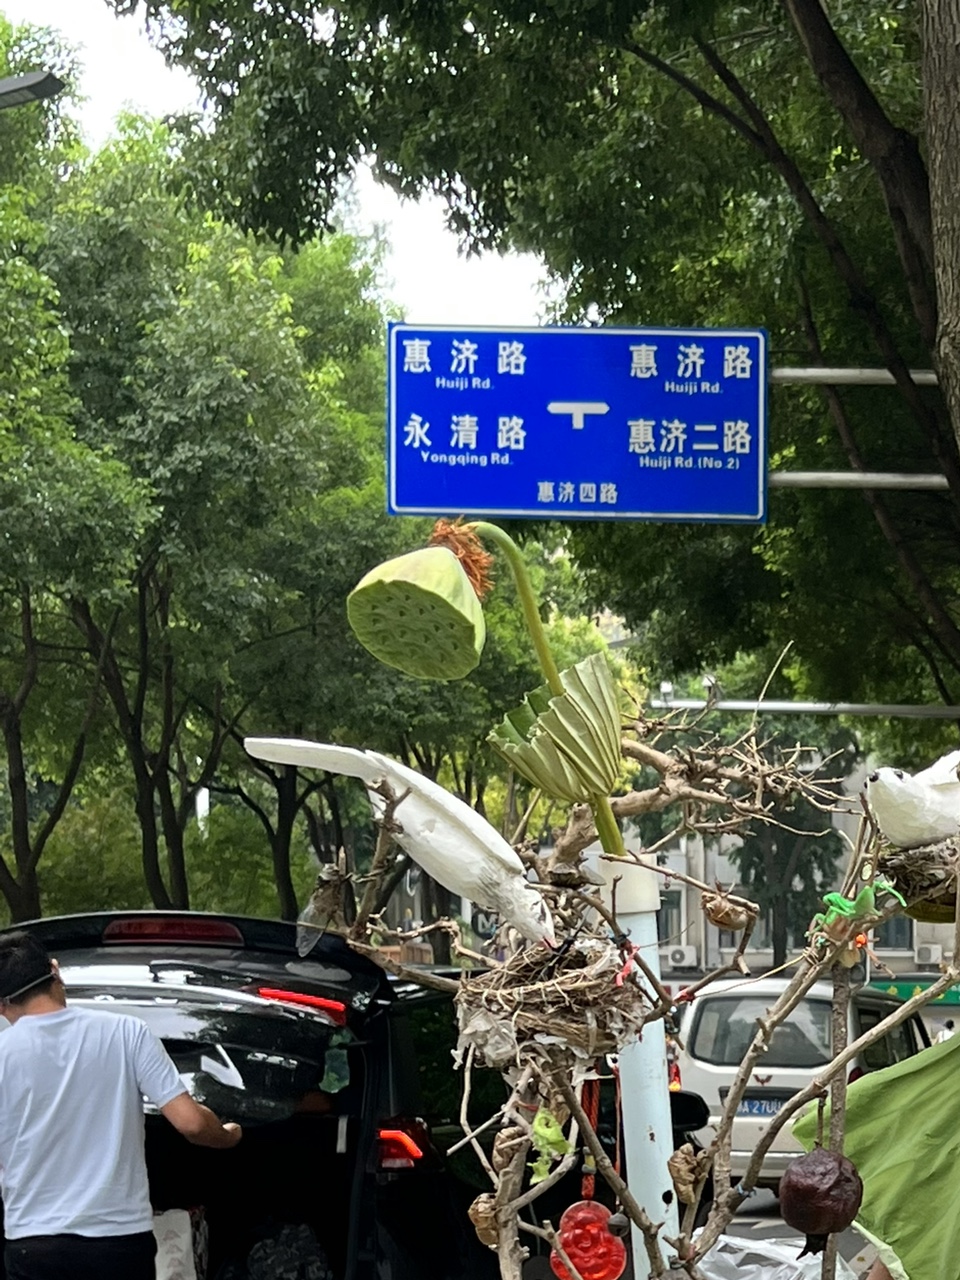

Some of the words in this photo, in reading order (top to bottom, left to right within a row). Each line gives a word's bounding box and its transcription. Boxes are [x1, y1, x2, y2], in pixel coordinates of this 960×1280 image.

[403, 338, 526, 375] 惠济路
[629, 344, 753, 379] 惠济路
[435, 377, 469, 391] Huiji
[665, 381, 698, 396] Huiji
[403, 413, 527, 450] 永清路
[627, 418, 752, 454] 惠济二路
[421, 450, 488, 467] Yongqing
[639, 456, 672, 470] Huiji
[537, 481, 618, 504] 惠济四路
